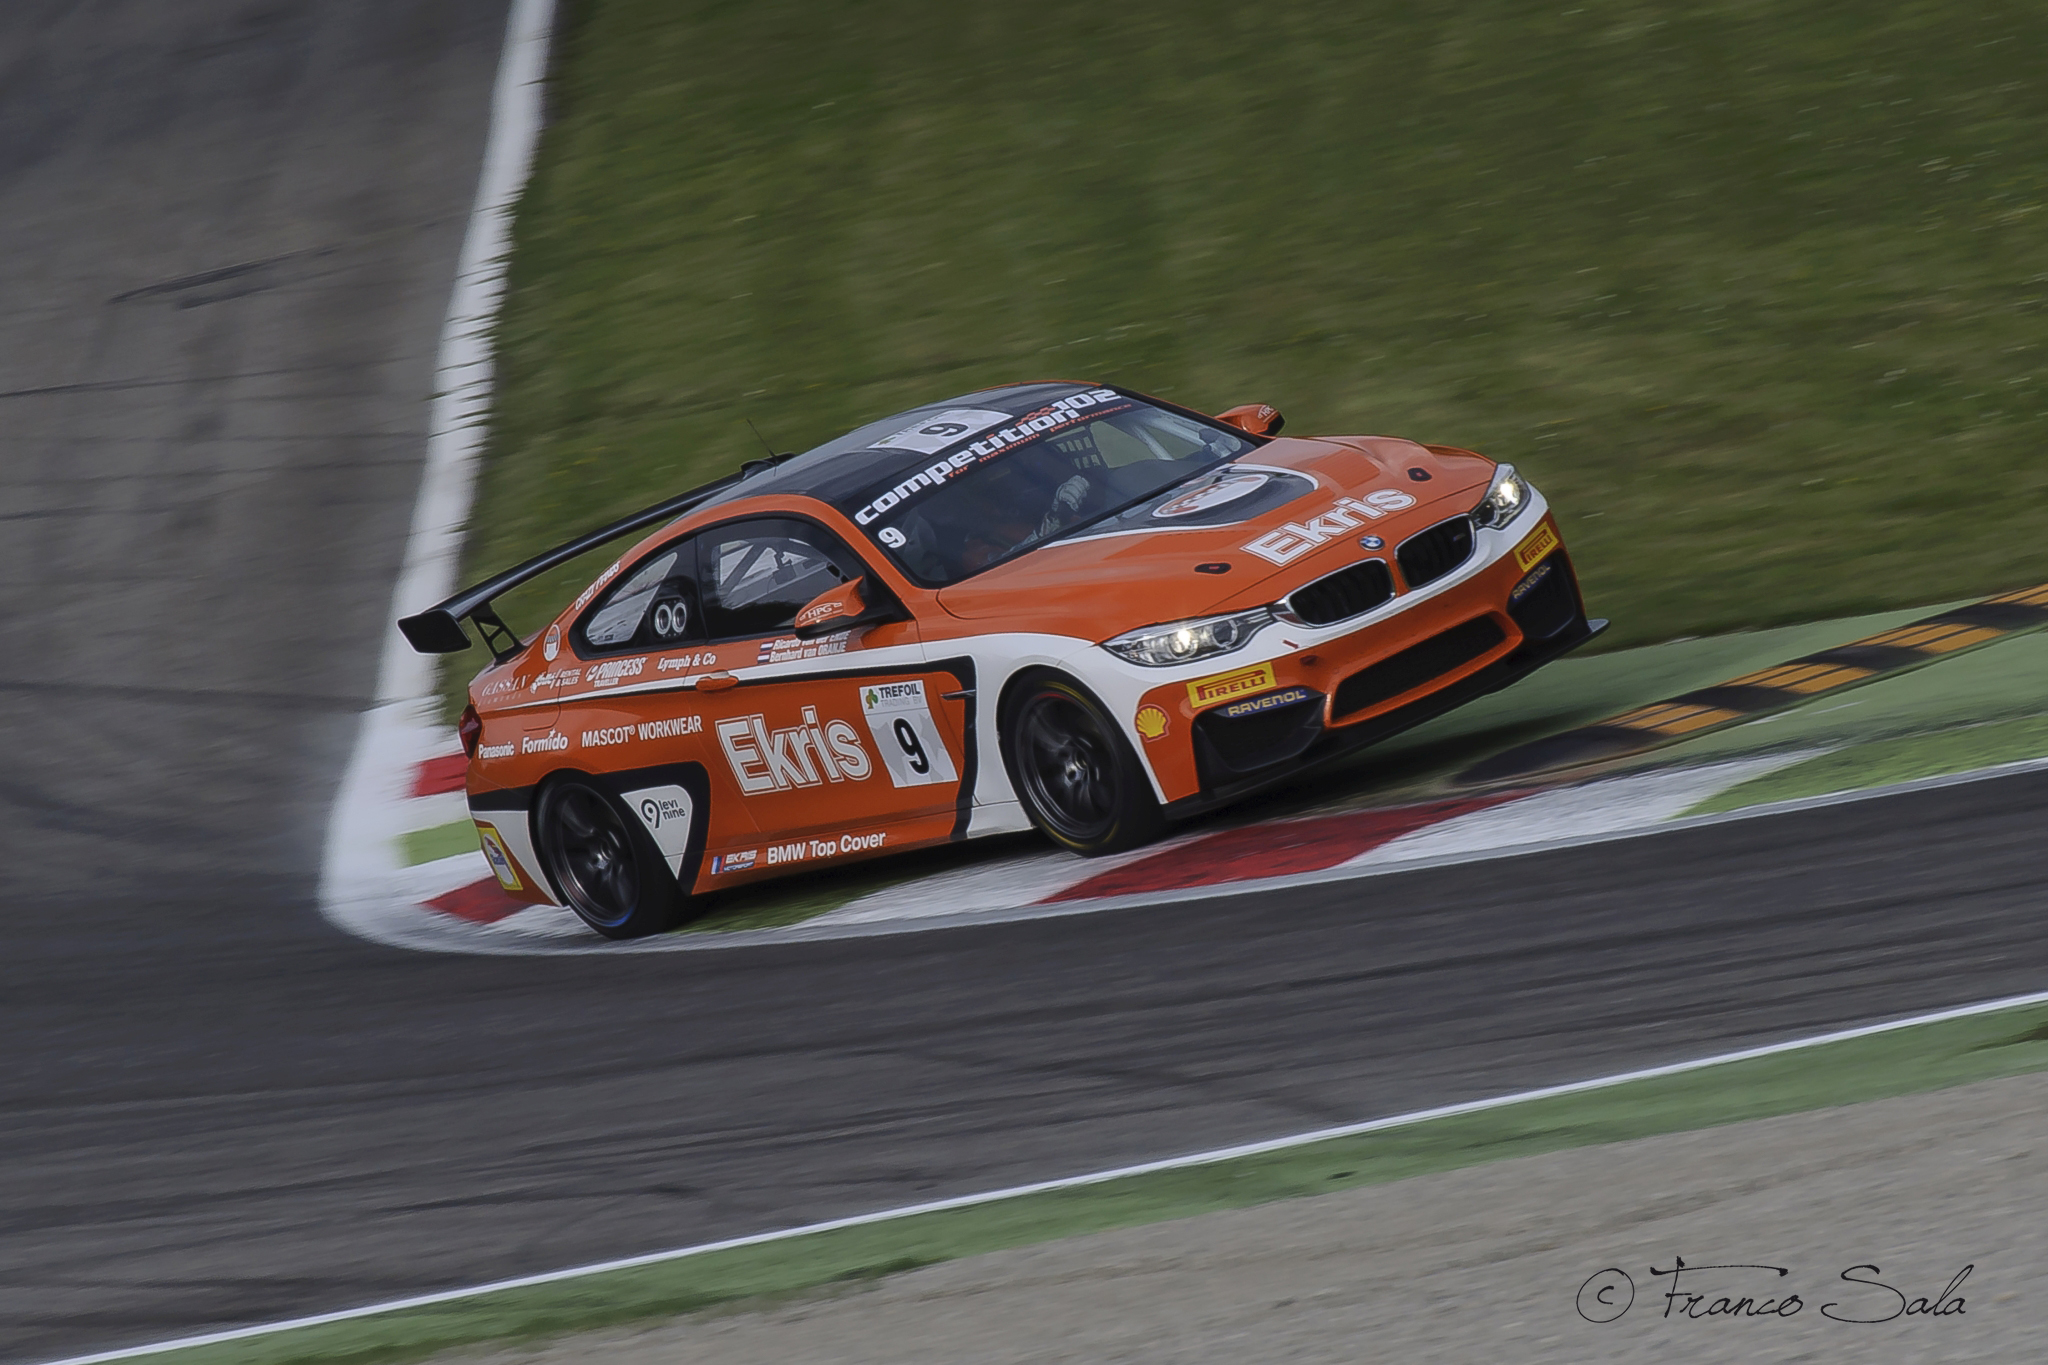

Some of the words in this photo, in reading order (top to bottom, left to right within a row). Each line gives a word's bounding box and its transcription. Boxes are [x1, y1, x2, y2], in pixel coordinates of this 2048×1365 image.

[919, 422, 970, 438] 9
[854, 408, 1081, 525] competition
[1052, 389, 1121, 412] 102
[878, 526, 907, 549] 9
[1238, 488, 1418, 567] Ekris
[1519, 528, 1554, 566] PIRELLI
[1512, 564, 1551, 599] RAVENOL
[807, 604, 833, 619] HPG
[595, 657, 648, 680] PRINCESS
[658, 655, 691, 672] Lymph
[692, 654, 701, 667] &
[702, 652, 717, 666] Co
[879, 683, 921, 699] TREFOIL
[1195, 669, 1267, 702] PIRELLI
[1227, 691, 1307, 717] RAVENOL
[638, 716, 703, 741] WORKWEAR
[478, 741, 515, 760] Panasonic
[522, 729, 569, 755] Formido
[714, 704, 873, 797] Ekris
[893, 717, 930, 775] 9
[767, 842, 807, 865] BMW
[809, 839, 837, 859] Top
[840, 831, 887, 853] Cover
